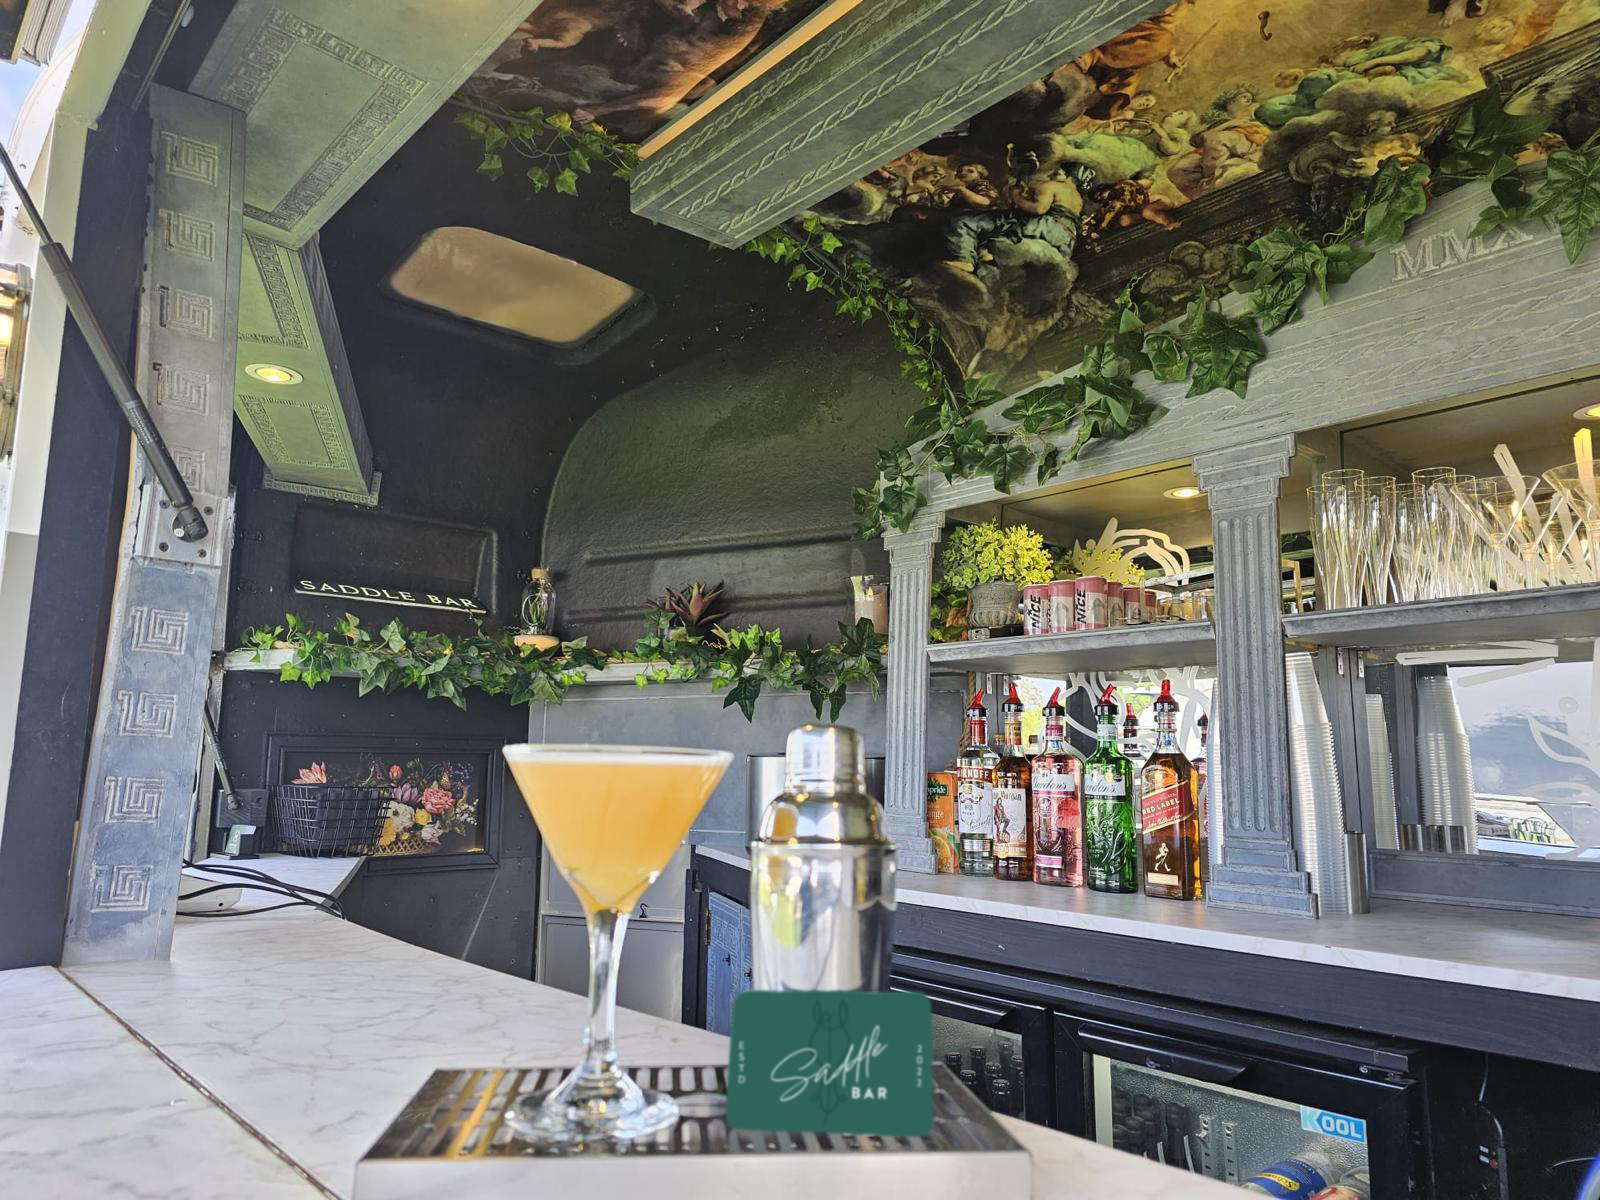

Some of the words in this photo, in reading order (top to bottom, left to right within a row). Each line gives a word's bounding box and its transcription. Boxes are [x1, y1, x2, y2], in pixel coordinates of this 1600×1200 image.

[300, 580, 416, 601] SADDLE
[427, 594, 478, 608] BAR
[1142, 805, 1156, 816] RED
[1157, 797, 1180, 810] LABEL
[738, 1041, 746, 1084] ESTD
[770, 1025, 888, 1102] Saddle
[851, 1086, 888, 1099] BAR
[1301, 1105, 1364, 1140] KOOL
